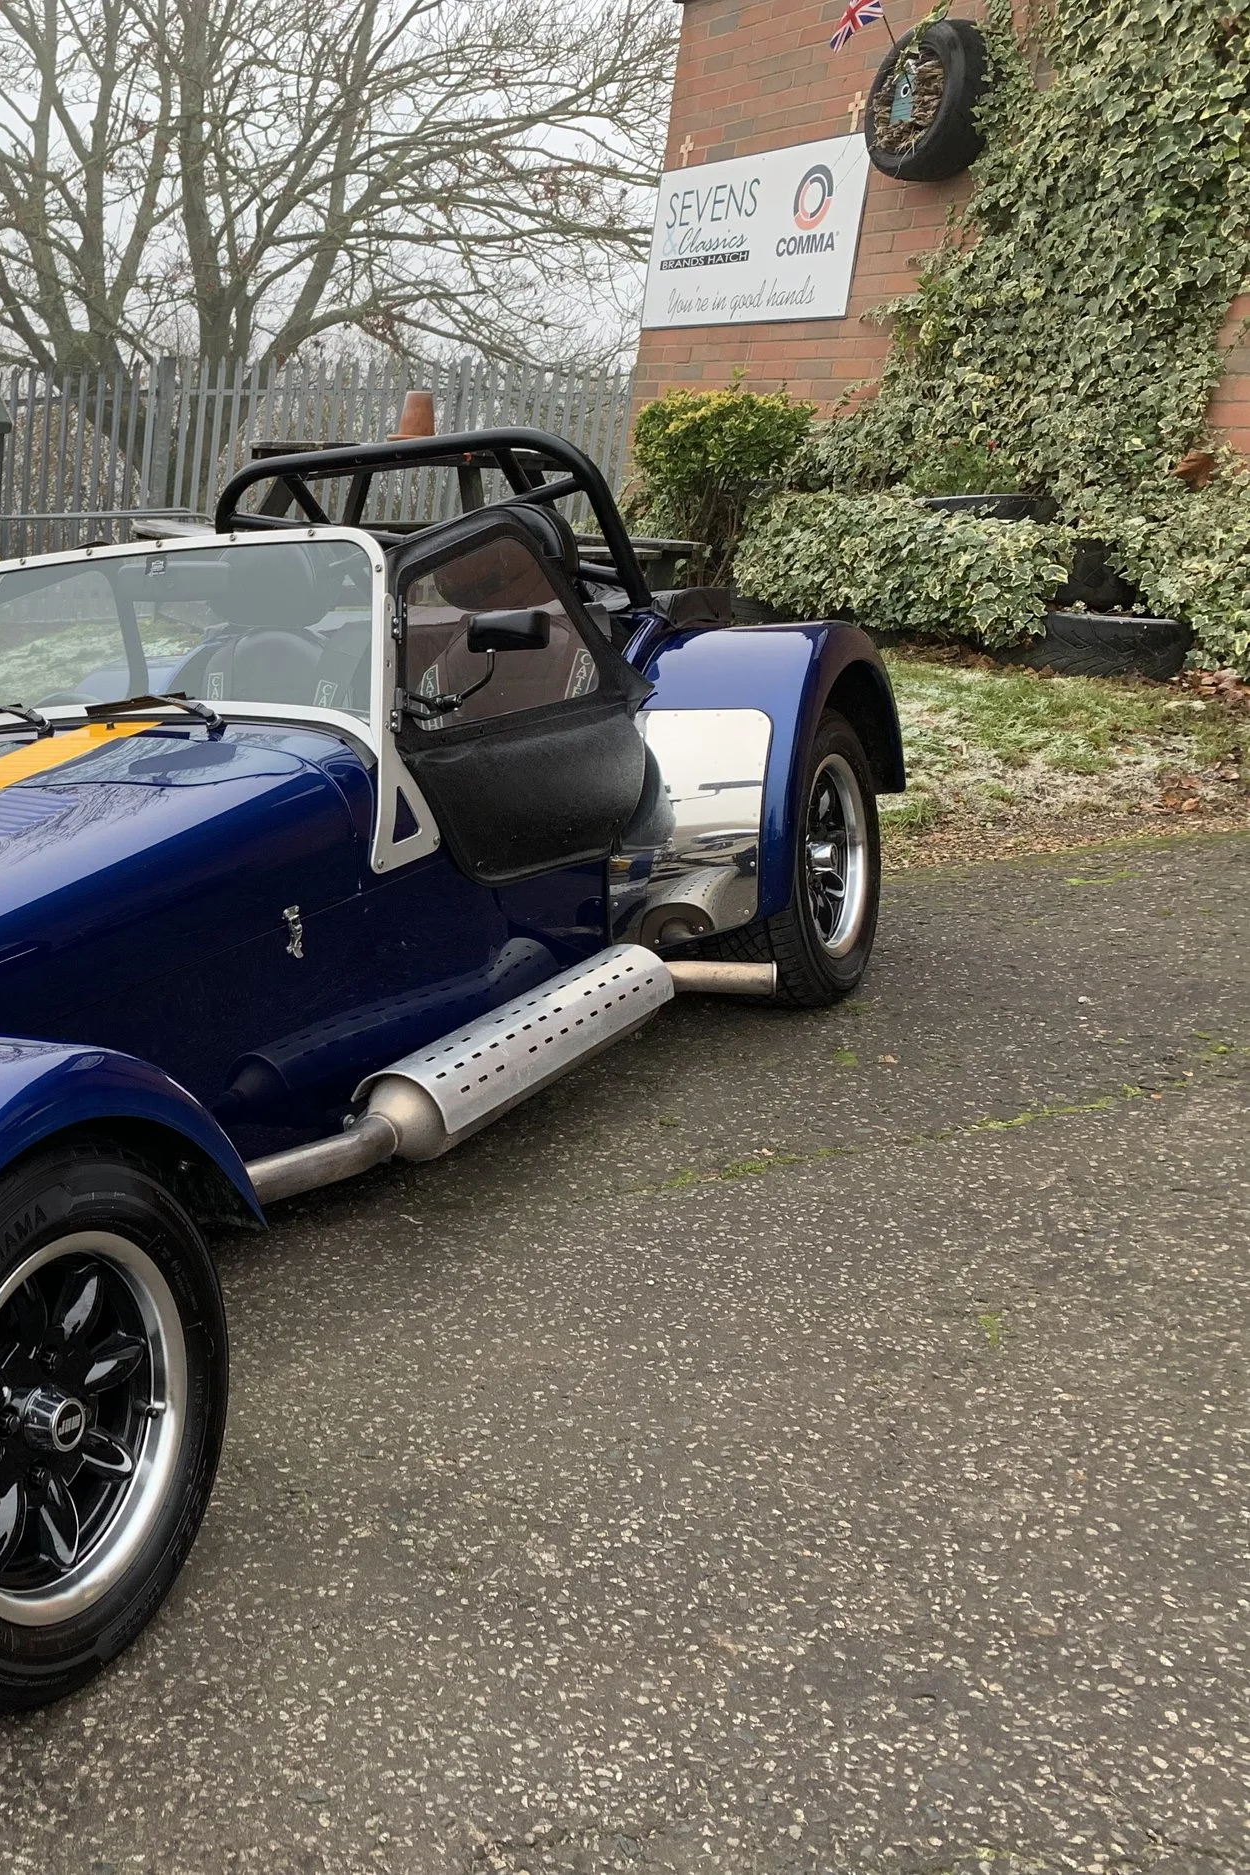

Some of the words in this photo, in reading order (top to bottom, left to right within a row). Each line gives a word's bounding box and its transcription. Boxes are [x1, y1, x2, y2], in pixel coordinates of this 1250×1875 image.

[666, 178, 761, 229] SEVENS
[678, 227, 748, 256] Classics
[776, 231, 836, 258] COMMA
[661, 257, 705, 270] BRANDS
[707, 252, 749, 266] HATCH
[667, 285, 709, 322] You're
[712, 287, 728, 311] in
[730, 279, 767, 320] good
[766, 274, 816, 308] hands
